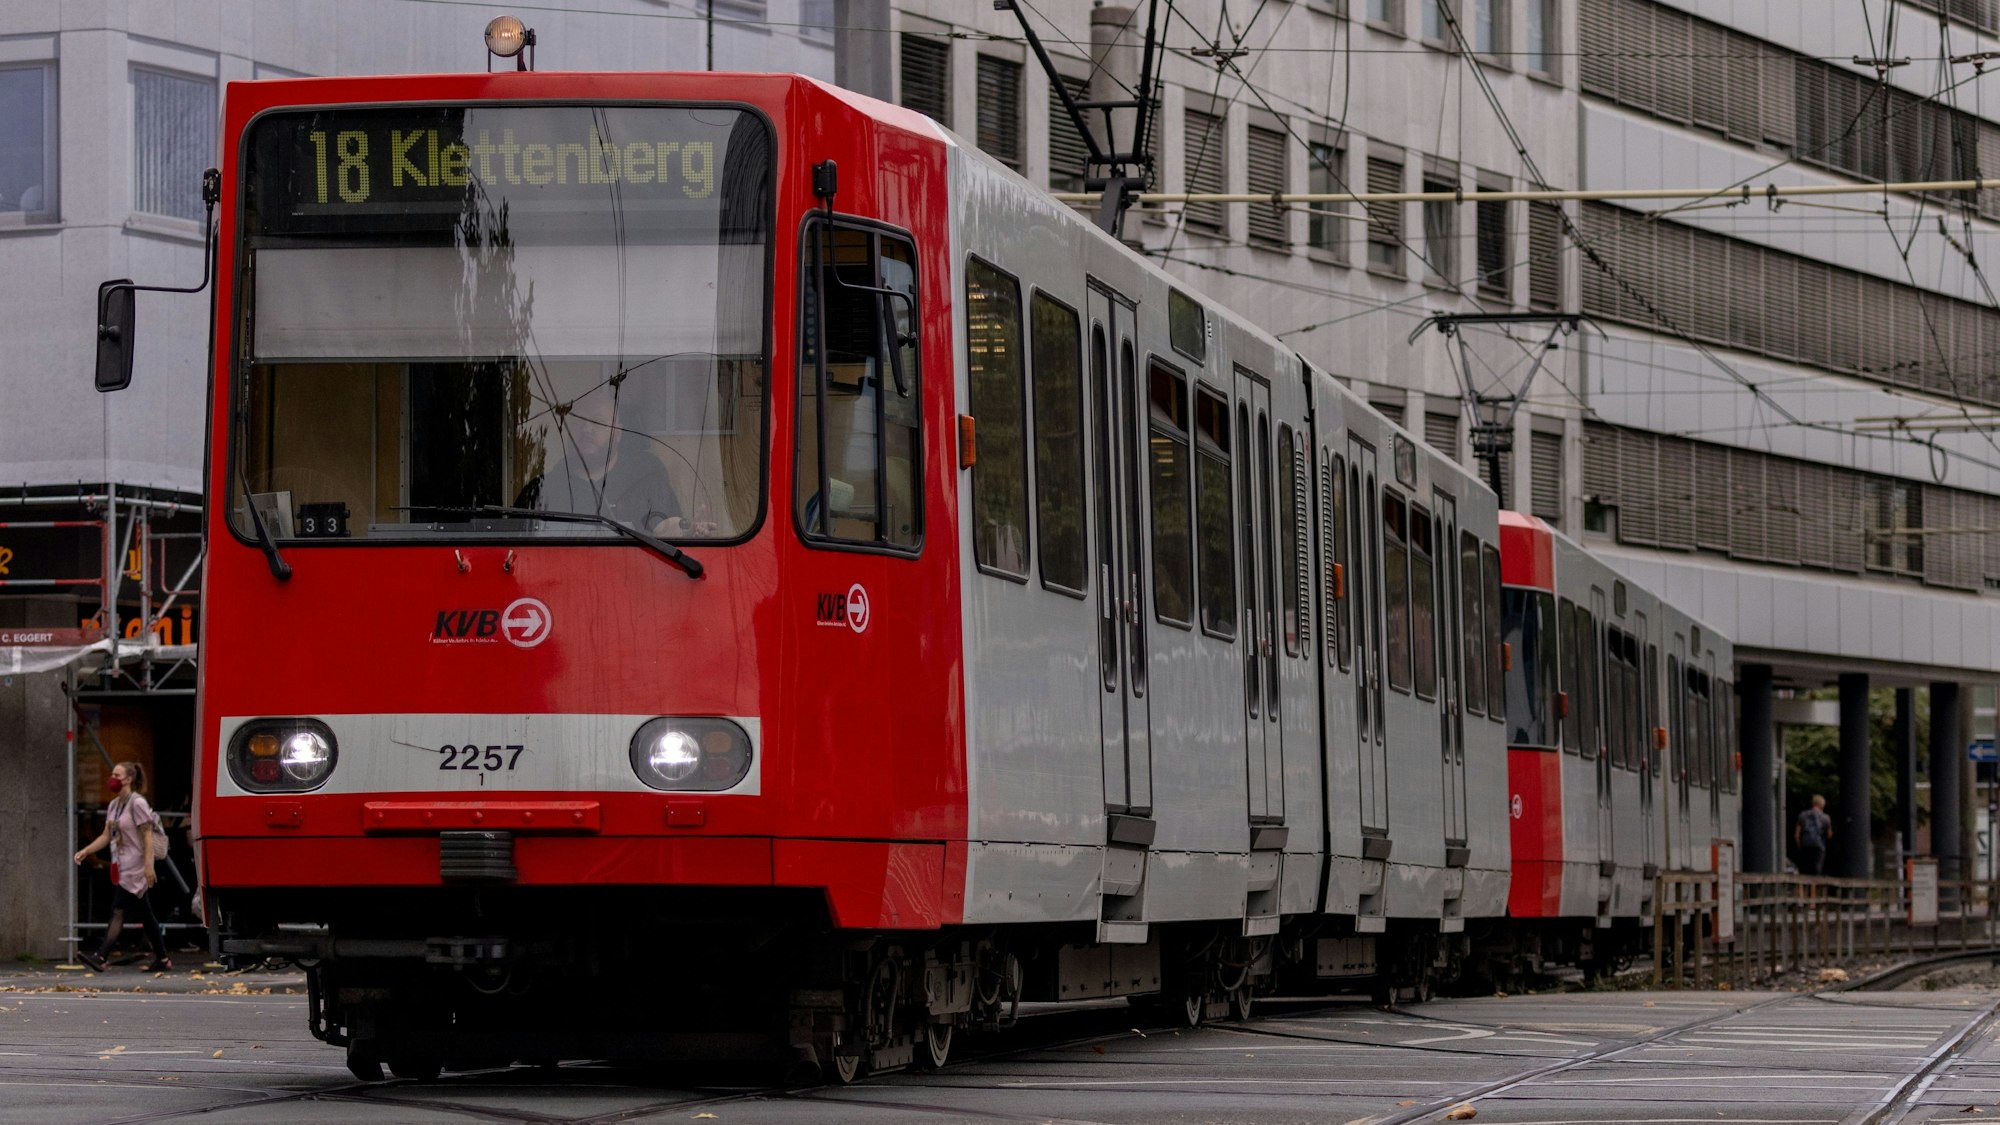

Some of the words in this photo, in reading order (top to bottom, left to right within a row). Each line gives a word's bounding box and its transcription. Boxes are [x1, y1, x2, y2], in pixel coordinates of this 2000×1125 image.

[309, 130, 371, 203] 18
[391, 124, 714, 199] Klettenberg
[816, 593, 846, 620] KVB
[434, 609, 499, 637] KVB
[13, 633, 53, 643] EGGERT
[439, 744, 524, 771] 2257
[478, 772, 484, 786] 1
